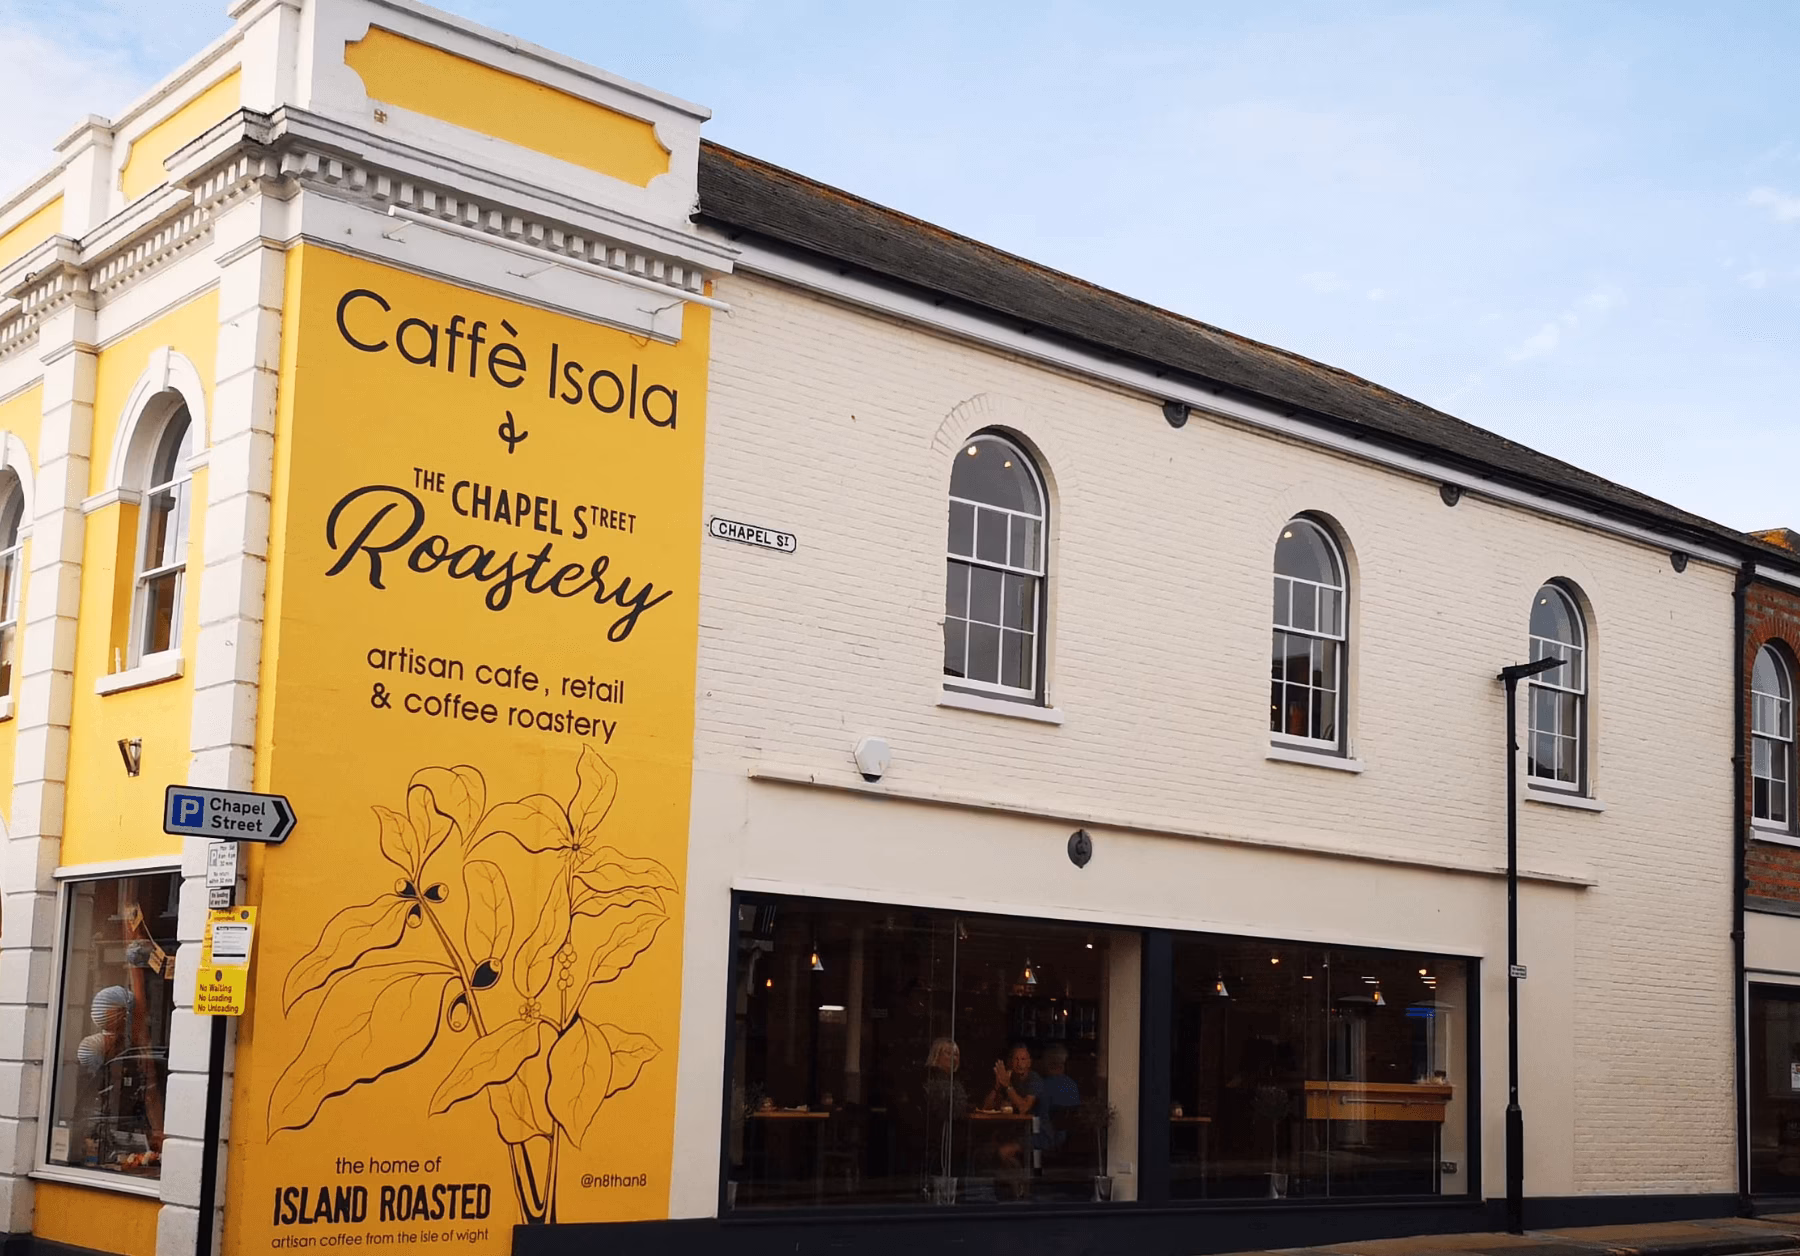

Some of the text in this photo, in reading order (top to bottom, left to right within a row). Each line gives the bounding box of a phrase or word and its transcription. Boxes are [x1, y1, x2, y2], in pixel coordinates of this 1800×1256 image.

[336, 288, 679, 430] Caffè Isola
[498, 410, 529, 454] &
[412, 467, 637, 540] THE CHAPEL STREET
[718, 522, 772, 545] CHAPEL
[325, 484, 673, 642] Roastery
[367, 647, 464, 681] artisan
[561, 676, 624, 704] retail
[370, 682, 617, 744] & coffee roastery
[180, 798, 200, 823] P
[209, 797, 266, 816] Chapel
[210, 815, 263, 832] Street
[198, 994, 232, 1003] No Loading
[199, 984, 232, 993] No Waiting
[197, 1004, 239, 1014] No Unloading
[335, 1155, 442, 1174] the home of
[580, 1173, 647, 1188] @n8than8
[273, 1183, 492, 1227] ISLAND ROASTED
[271, 1228, 489, 1249] artisan coffee from the isle of wight
